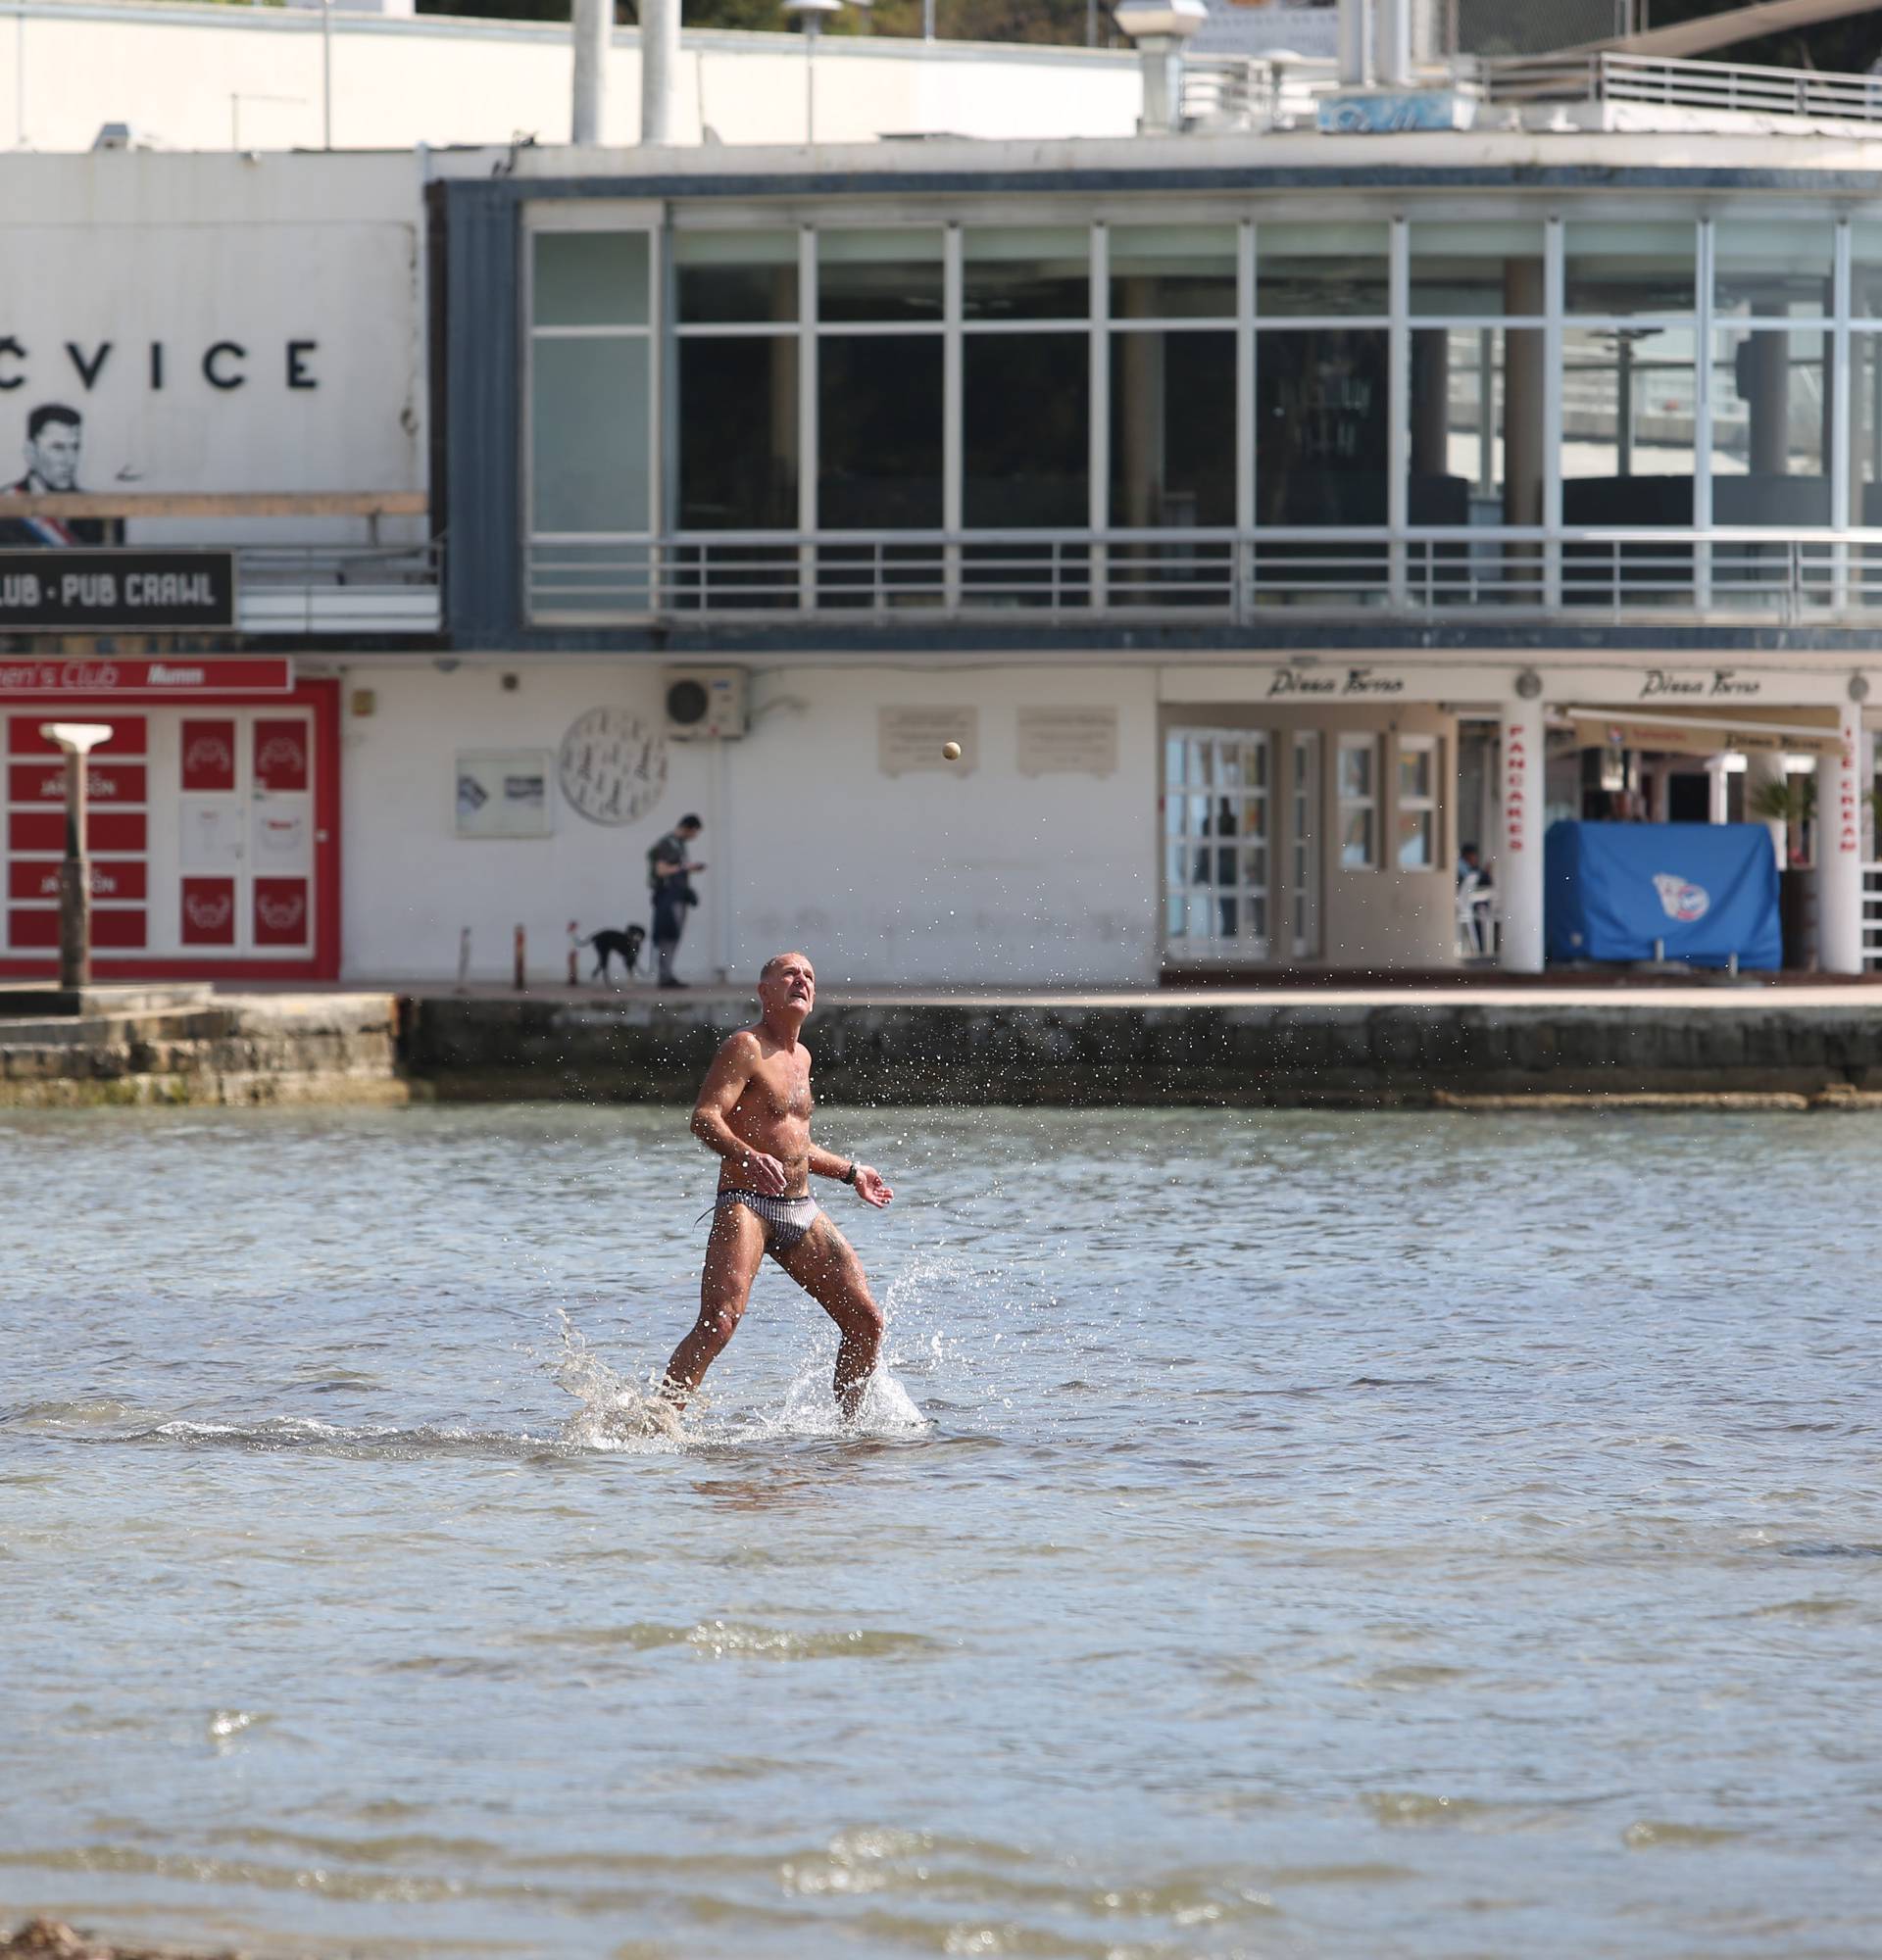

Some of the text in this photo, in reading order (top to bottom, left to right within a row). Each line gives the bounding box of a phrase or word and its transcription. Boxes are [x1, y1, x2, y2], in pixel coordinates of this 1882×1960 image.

[0, 572, 216, 607] UB PUB CRAWL
[62, 658, 119, 688] Club
